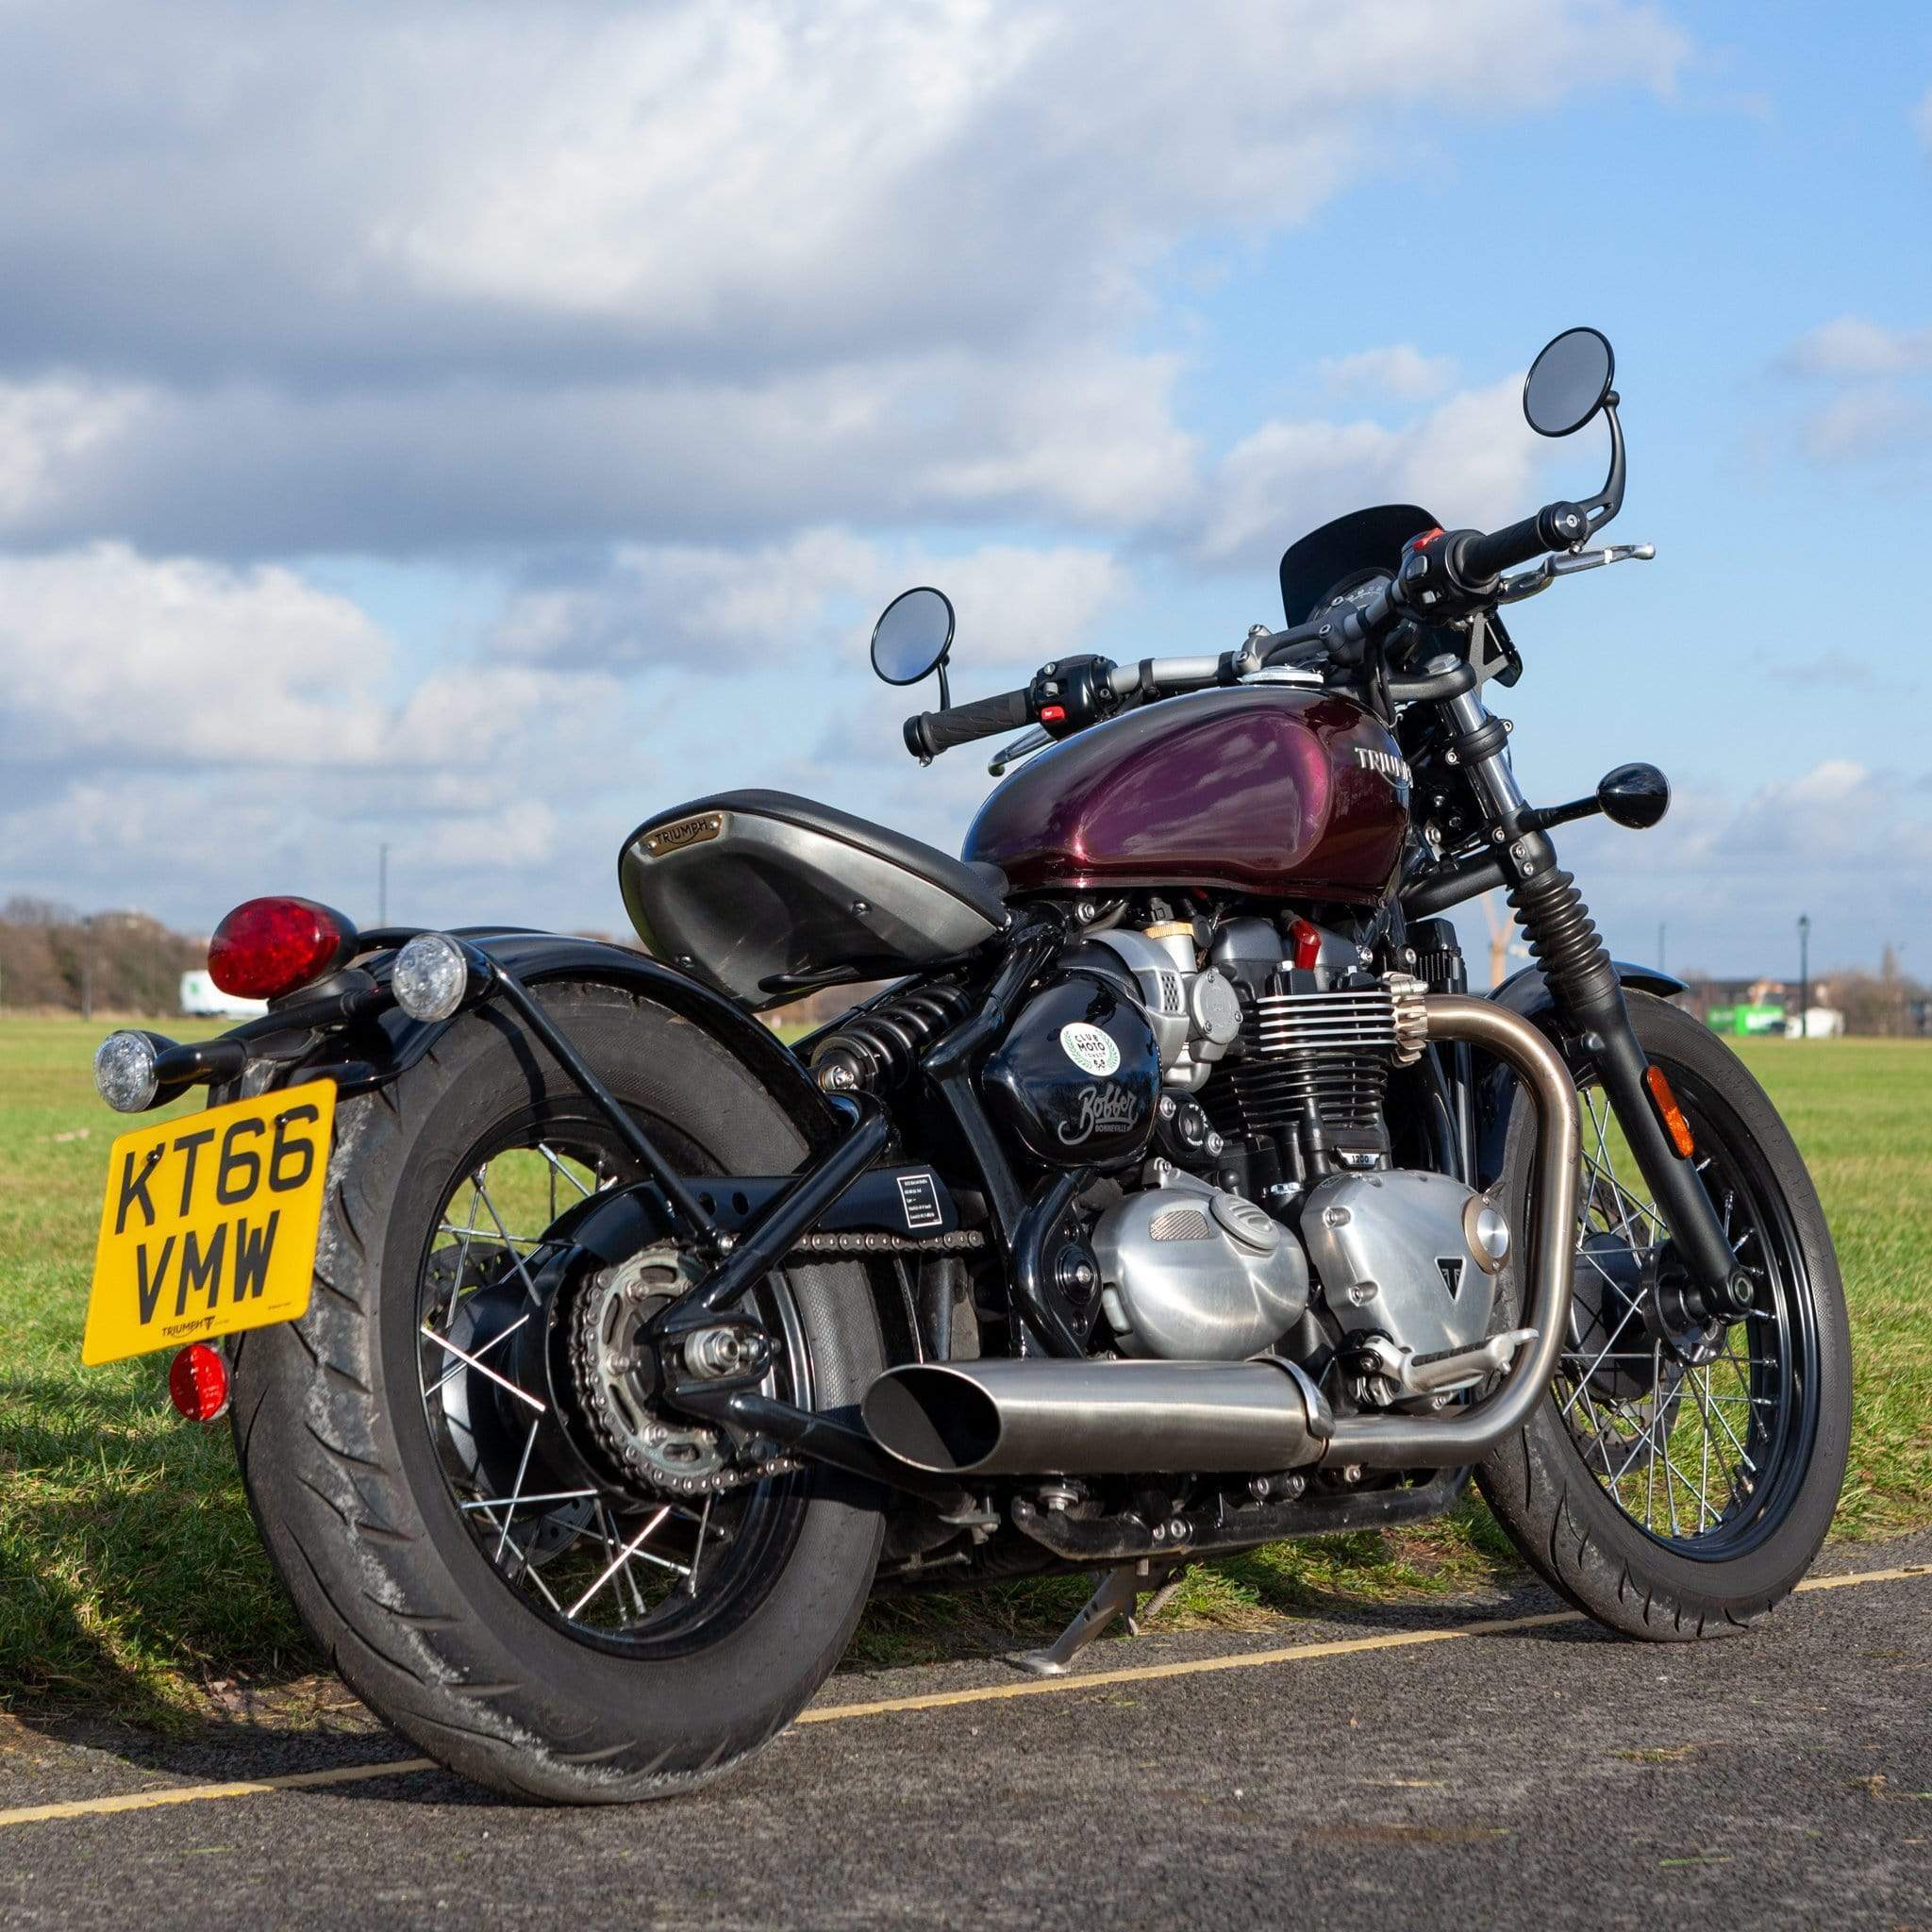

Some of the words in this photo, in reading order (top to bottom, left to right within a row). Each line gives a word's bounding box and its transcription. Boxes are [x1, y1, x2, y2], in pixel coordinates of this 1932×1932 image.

[655, 819, 708, 845] TRIUMPH
[1074, 1033, 1099, 1042] CLUB
[1077, 1042, 1106, 1052] MOTO
[1058, 1082, 1139, 1145] Bobber
[114, 1103, 319, 1235] KT66
[1352, 1155, 1370, 1163] 1200
[136, 1209, 280, 1325] VMW
[161, 1320, 203, 1339] TRIUMPH
